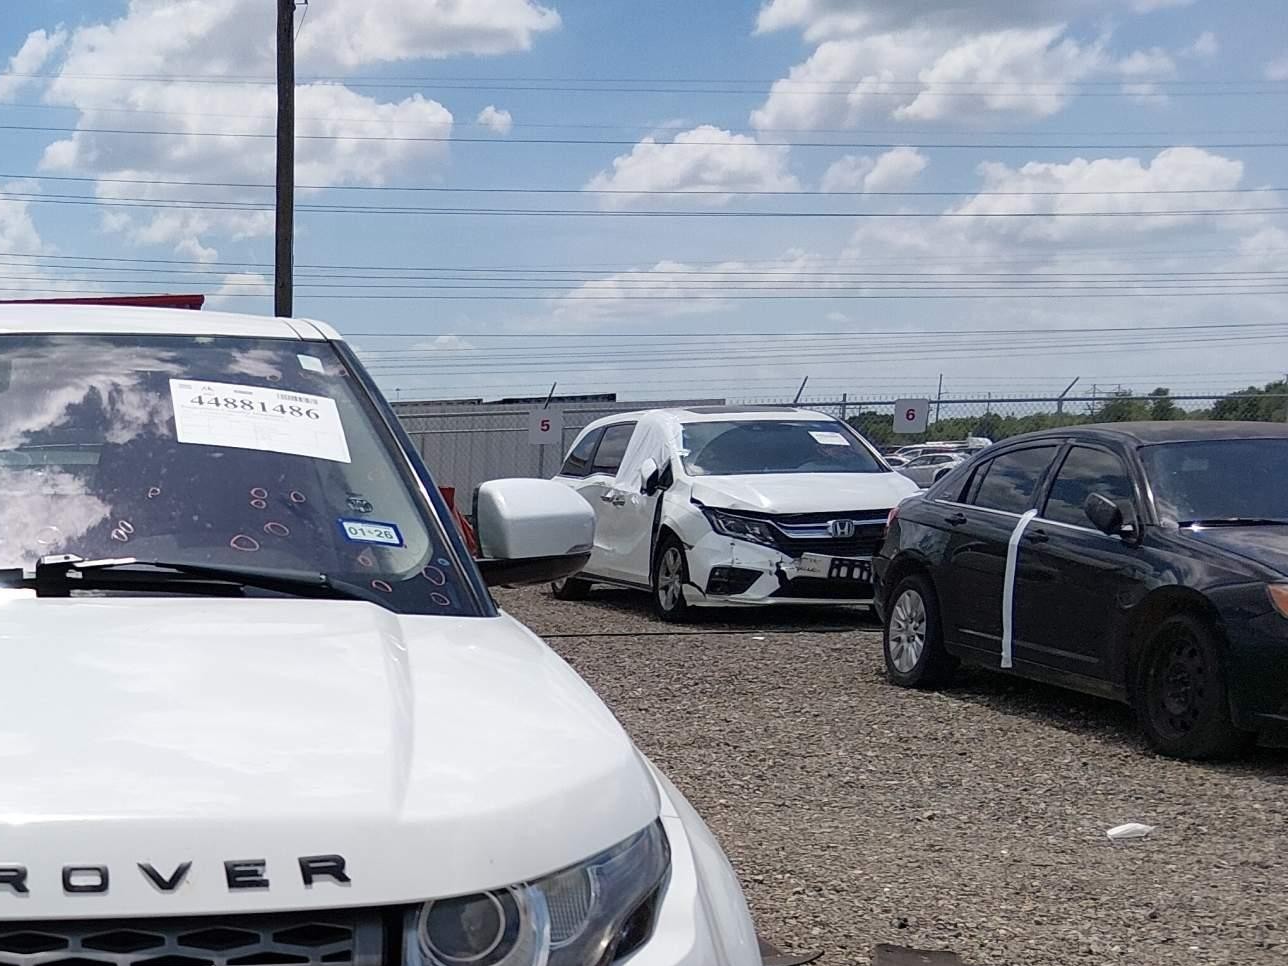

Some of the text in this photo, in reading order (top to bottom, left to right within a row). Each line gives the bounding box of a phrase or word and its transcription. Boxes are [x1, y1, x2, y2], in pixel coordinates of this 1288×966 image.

[190, 395, 320, 420] 44881486
[905, 409, 916, 421] 6
[540, 420, 550, 432] 5
